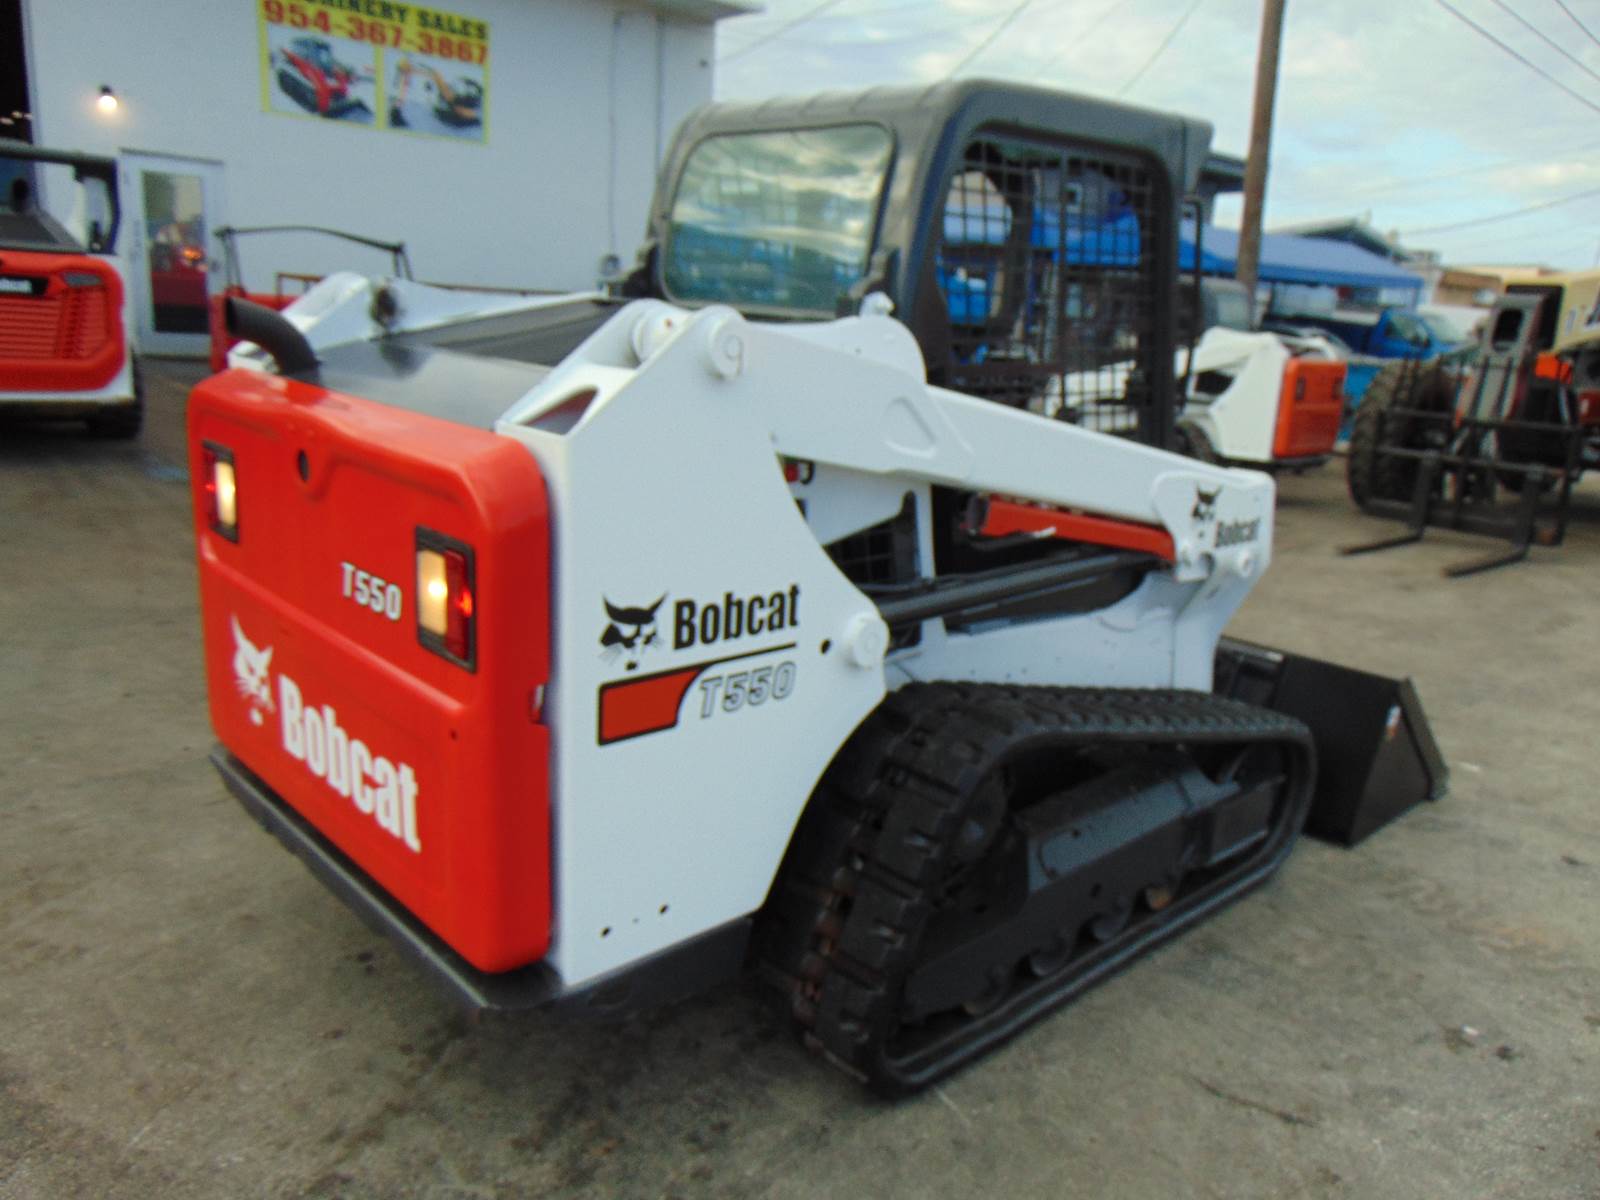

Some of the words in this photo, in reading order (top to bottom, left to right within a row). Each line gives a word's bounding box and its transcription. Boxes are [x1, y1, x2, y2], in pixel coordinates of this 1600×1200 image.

[263, 0, 488, 65] 954-367-3867
[304, 0, 408, 22] INERY
[416, 8, 488, 40] SALES
[1214, 517, 1261, 549] Bobcat
[341, 561, 403, 622] T550
[673, 583, 801, 651] Bobcat
[699, 660, 797, 720] T550
[278, 672, 422, 854] Bobcat
